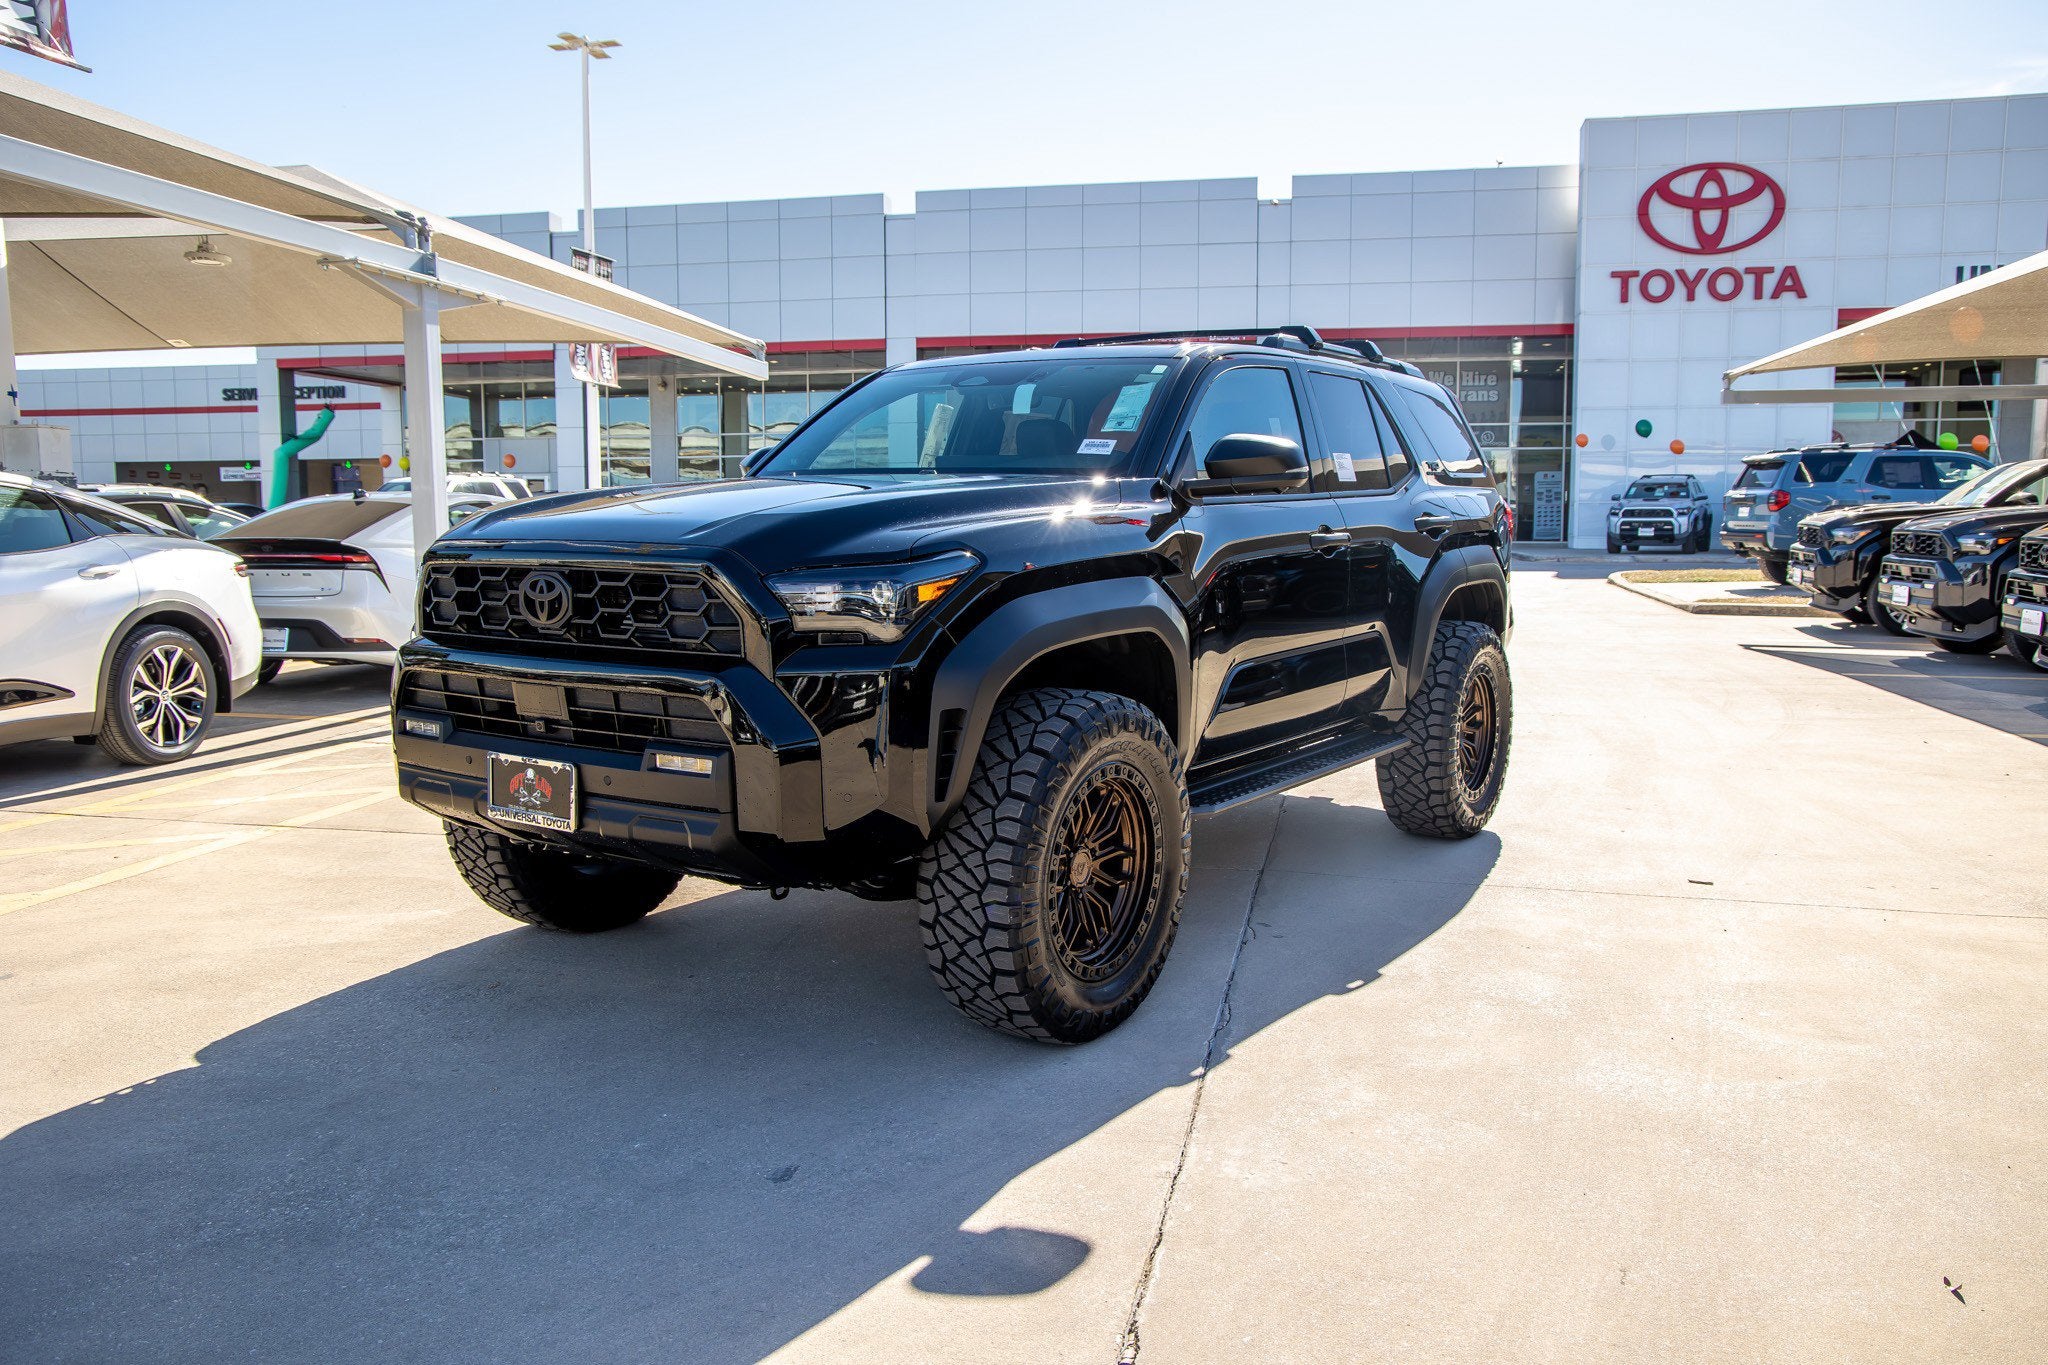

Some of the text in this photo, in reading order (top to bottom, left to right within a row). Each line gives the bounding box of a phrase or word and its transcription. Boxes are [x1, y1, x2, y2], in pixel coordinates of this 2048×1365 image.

[1611, 266, 1808, 303] TOYOTA
[1428, 370, 1498, 387] We Hire
[222, 385, 346, 401] SERVI CEPTION
[1460, 389, 1499, 402] rans
[500, 809, 541, 825] UNIVERSAL
[542, 816, 572, 831] TOYOTA
